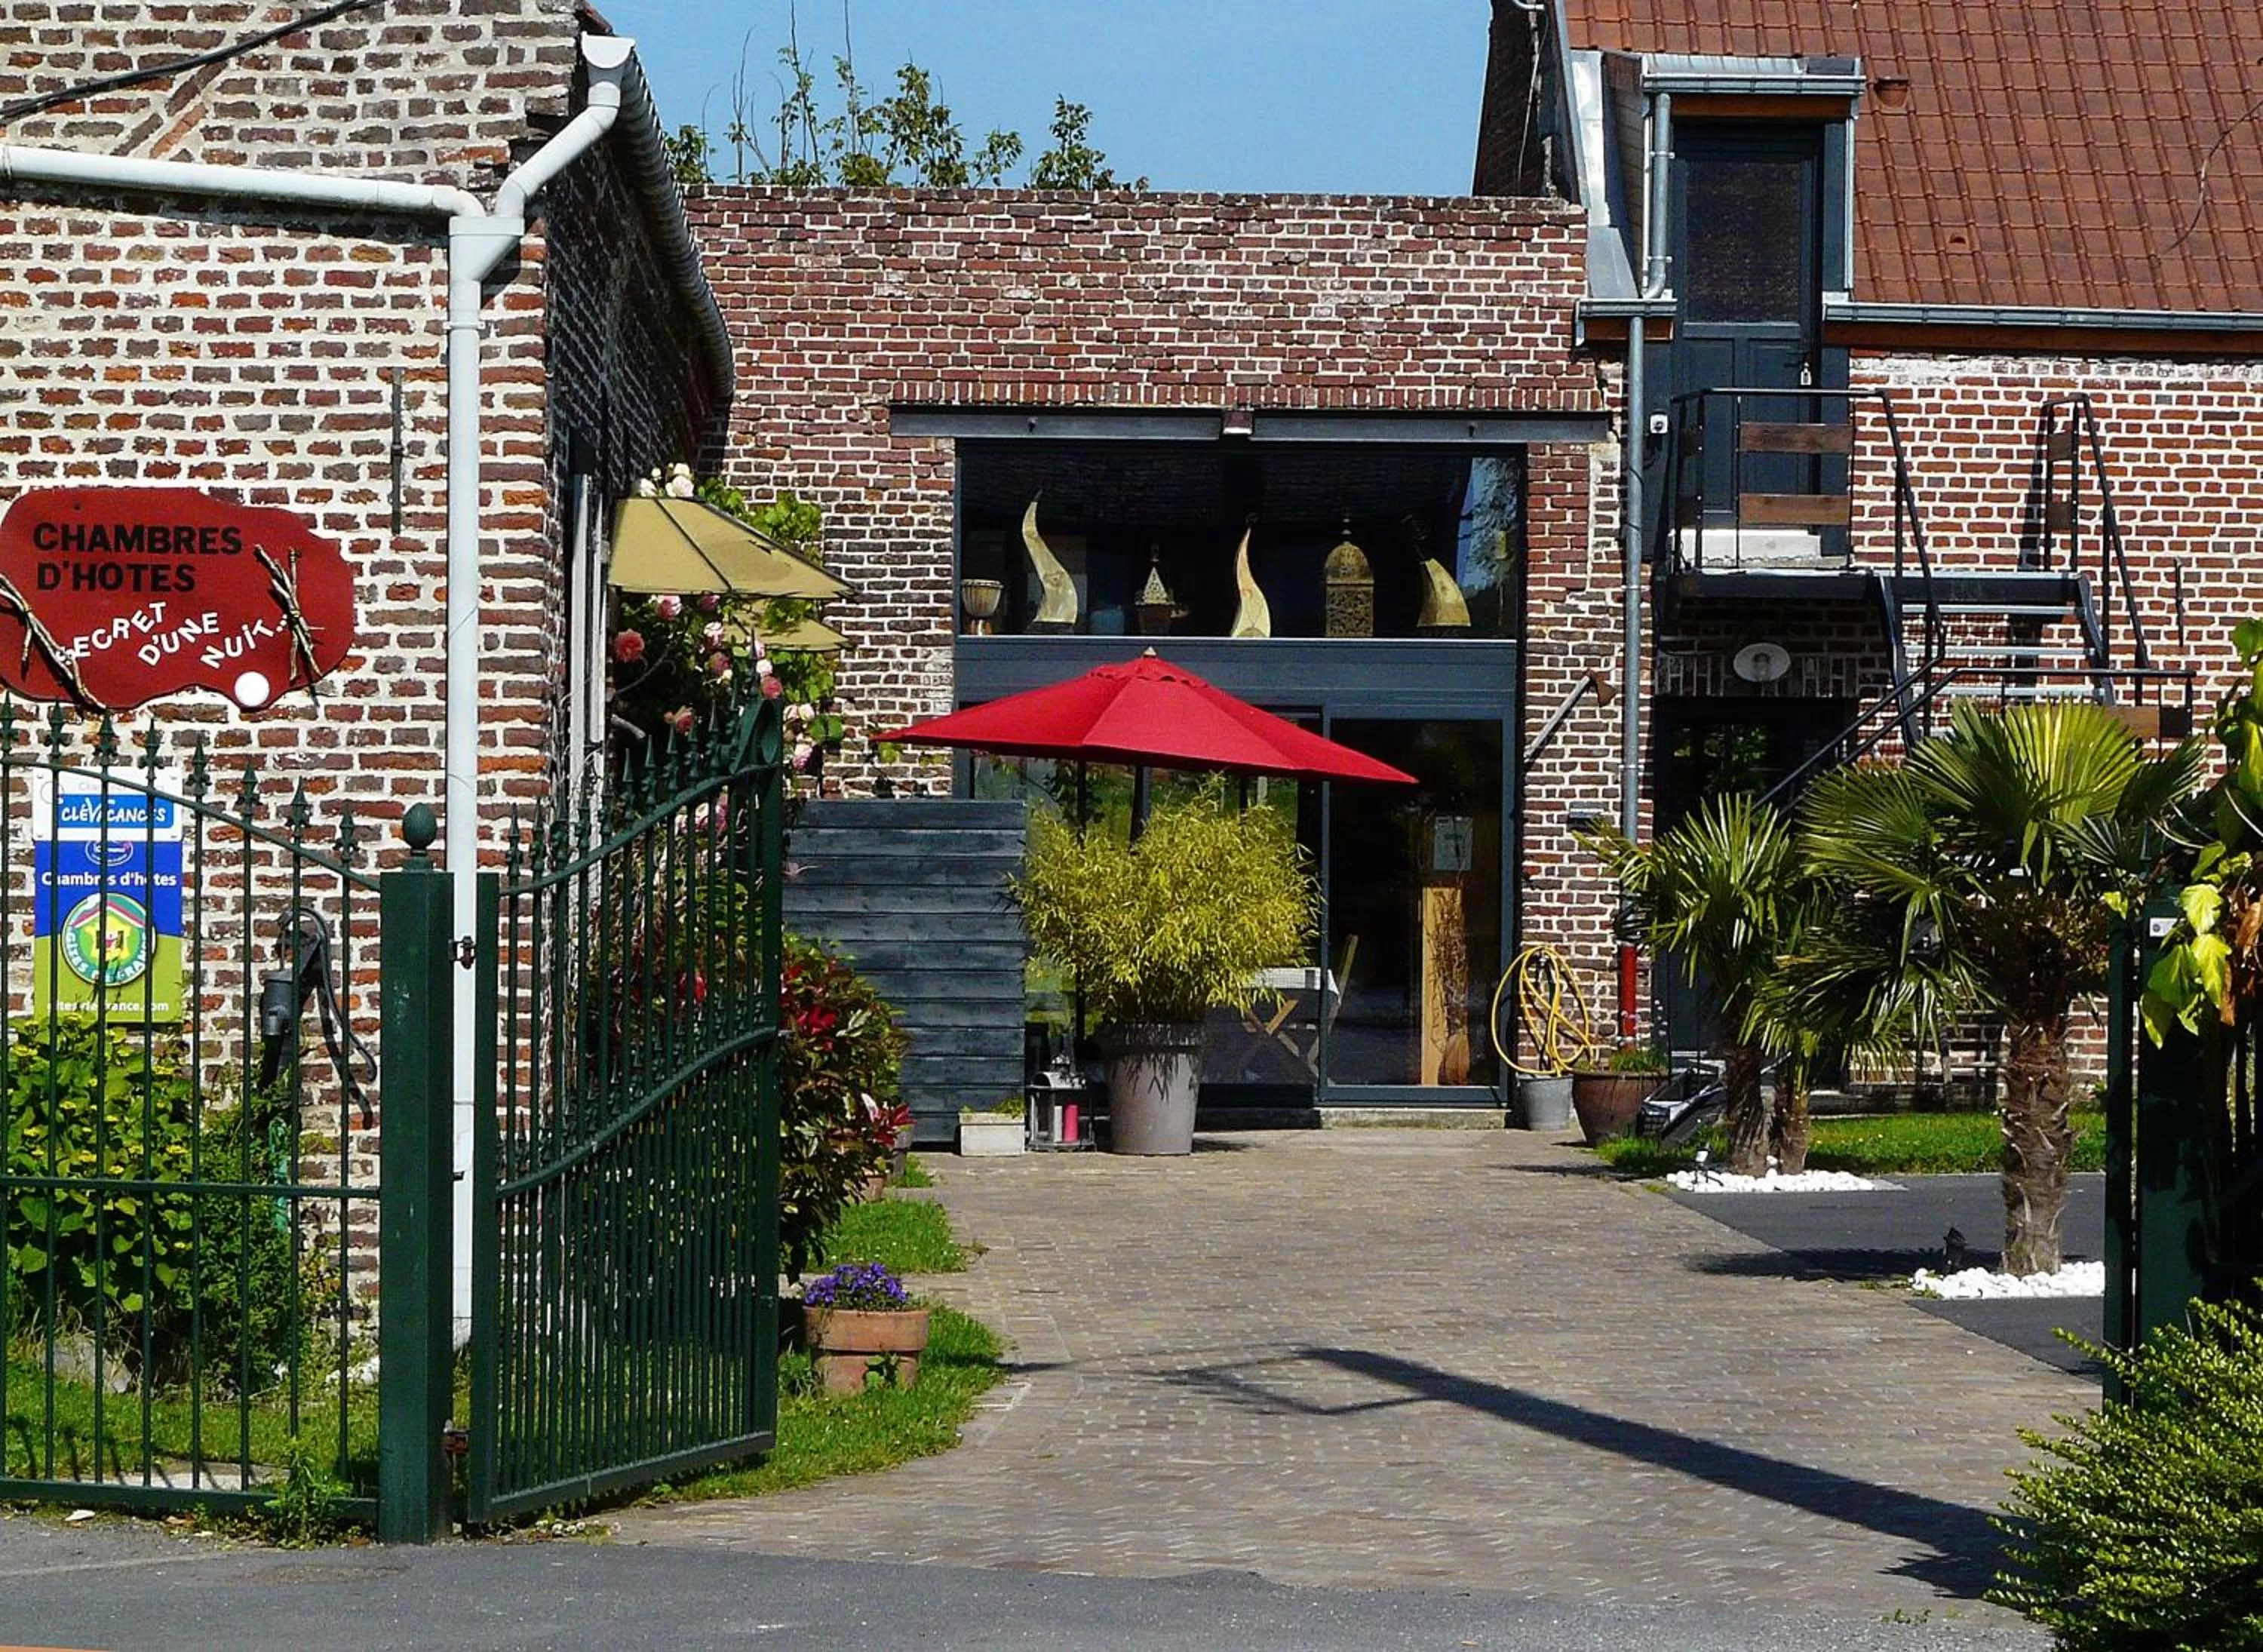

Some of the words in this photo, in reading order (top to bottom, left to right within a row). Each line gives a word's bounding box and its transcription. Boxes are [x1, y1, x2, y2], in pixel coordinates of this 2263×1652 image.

[33, 522, 242, 554] CHAMBRES
[38, 560, 196, 592] D'HOTES
[138, 613, 220, 666] D'UNE
[61, 797, 166, 823] CLÉVCANCS
[41, 871, 116, 886] Cambrs
[120, 871, 177, 886] d'htes
